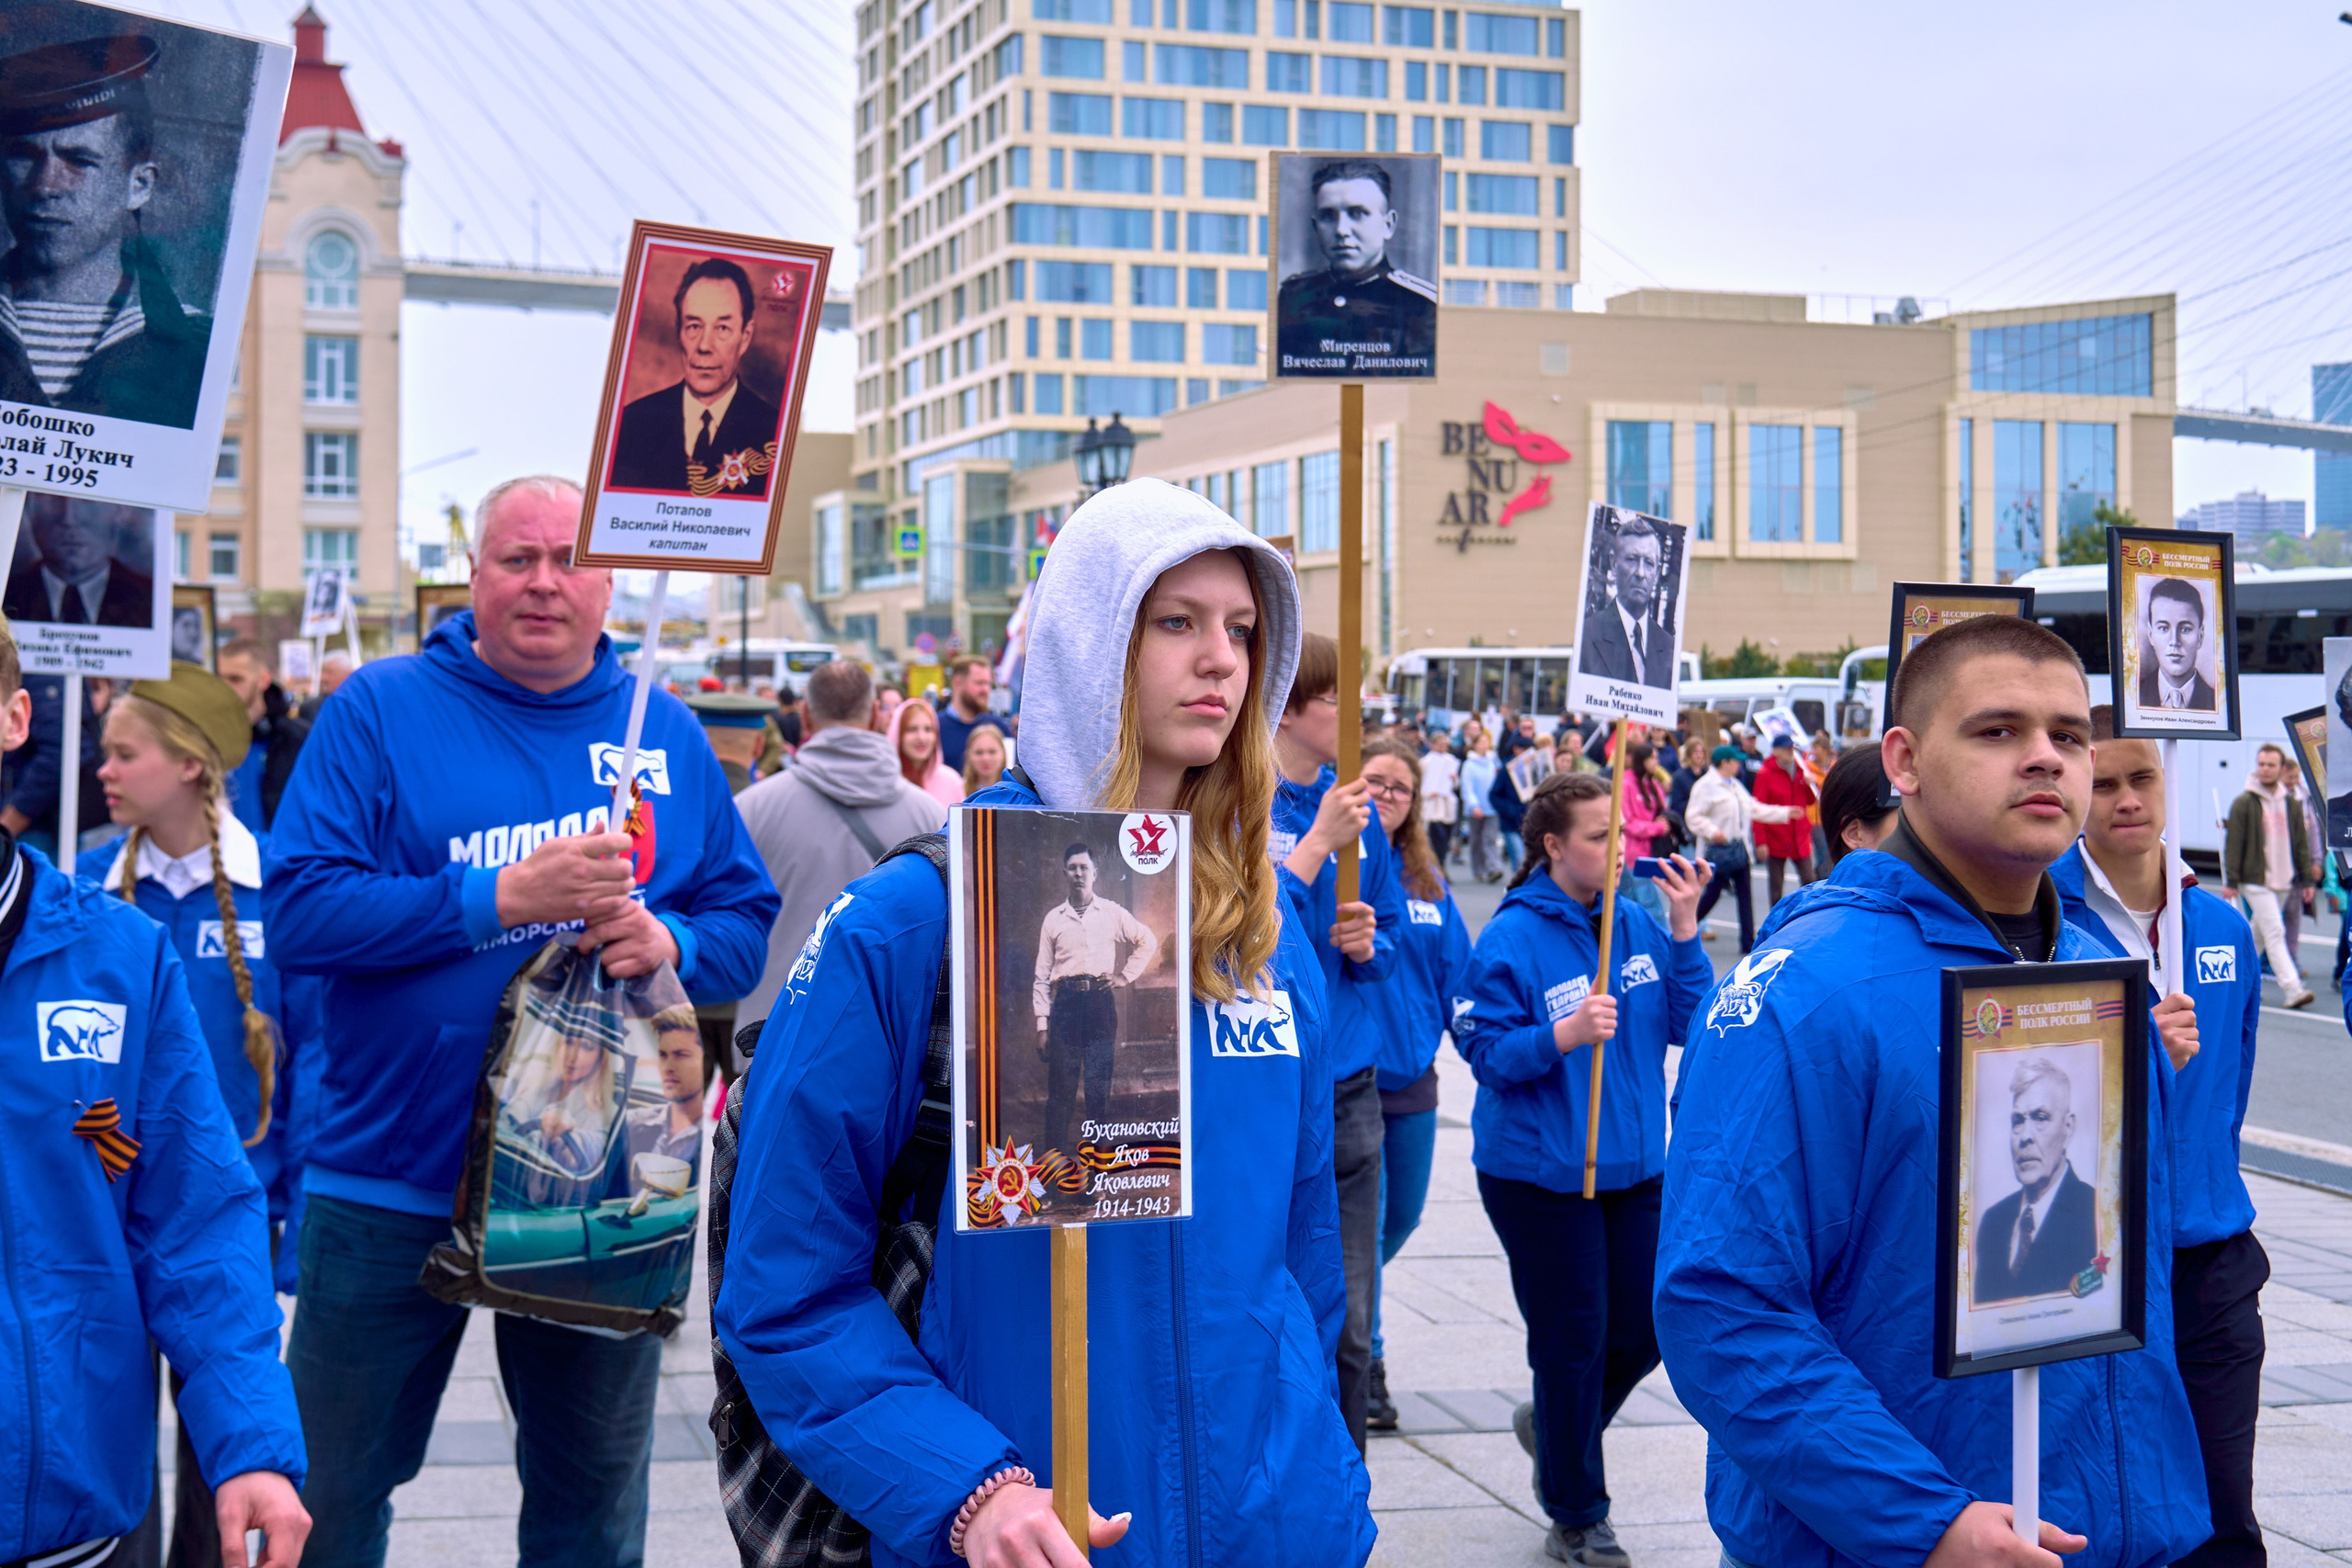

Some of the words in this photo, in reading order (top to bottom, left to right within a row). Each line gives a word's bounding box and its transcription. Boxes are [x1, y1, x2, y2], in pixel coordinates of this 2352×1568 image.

[1320, 339, 1391, 355] Миренцов
[1283, 355, 1347, 368] Вячеслав
[1352, 355, 1429, 370] Данилович
[0, 405, 96, 436] обошко
[1442, 422, 1489, 457] BE
[0, 435, 47, 456] лай
[53, 439, 134, 468] Лукич
[0, 456, 18, 477] 3
[43, 463, 100, 488] 1995
[1467, 459, 1517, 493] NU
[655, 502, 712, 518] Потапов
[1438, 491, 1490, 525] AR
[610, 516, 668, 532] Василий
[672, 521, 751, 536] Николаевич
[648, 537, 708, 552] капитан
[2162, 553, 2211, 563] БЕССМЕРТНЫЙ
[2183, 562, 2210, 570] РОССИИ
[1609, 685, 1643, 701] Рябенко
[1586, 694, 1609, 707] Иван
[1611, 699, 1664, 718] Михайлович
[1138, 857, 1159, 865] ПОЛК
[2017, 998, 2093, 1016] БЕССМЕРТНЫЙ
[2020, 1017, 2049, 1030] ПОЛК
[2050, 1013, 2091, 1026] РОССИИ
[1081, 1117, 1180, 1143] Бухановский
[1107, 1144, 1149, 1167] Яков
[1086, 1172, 1170, 1195] Яковлевич
[1092, 1196, 1170, 1219] 1914-1943
